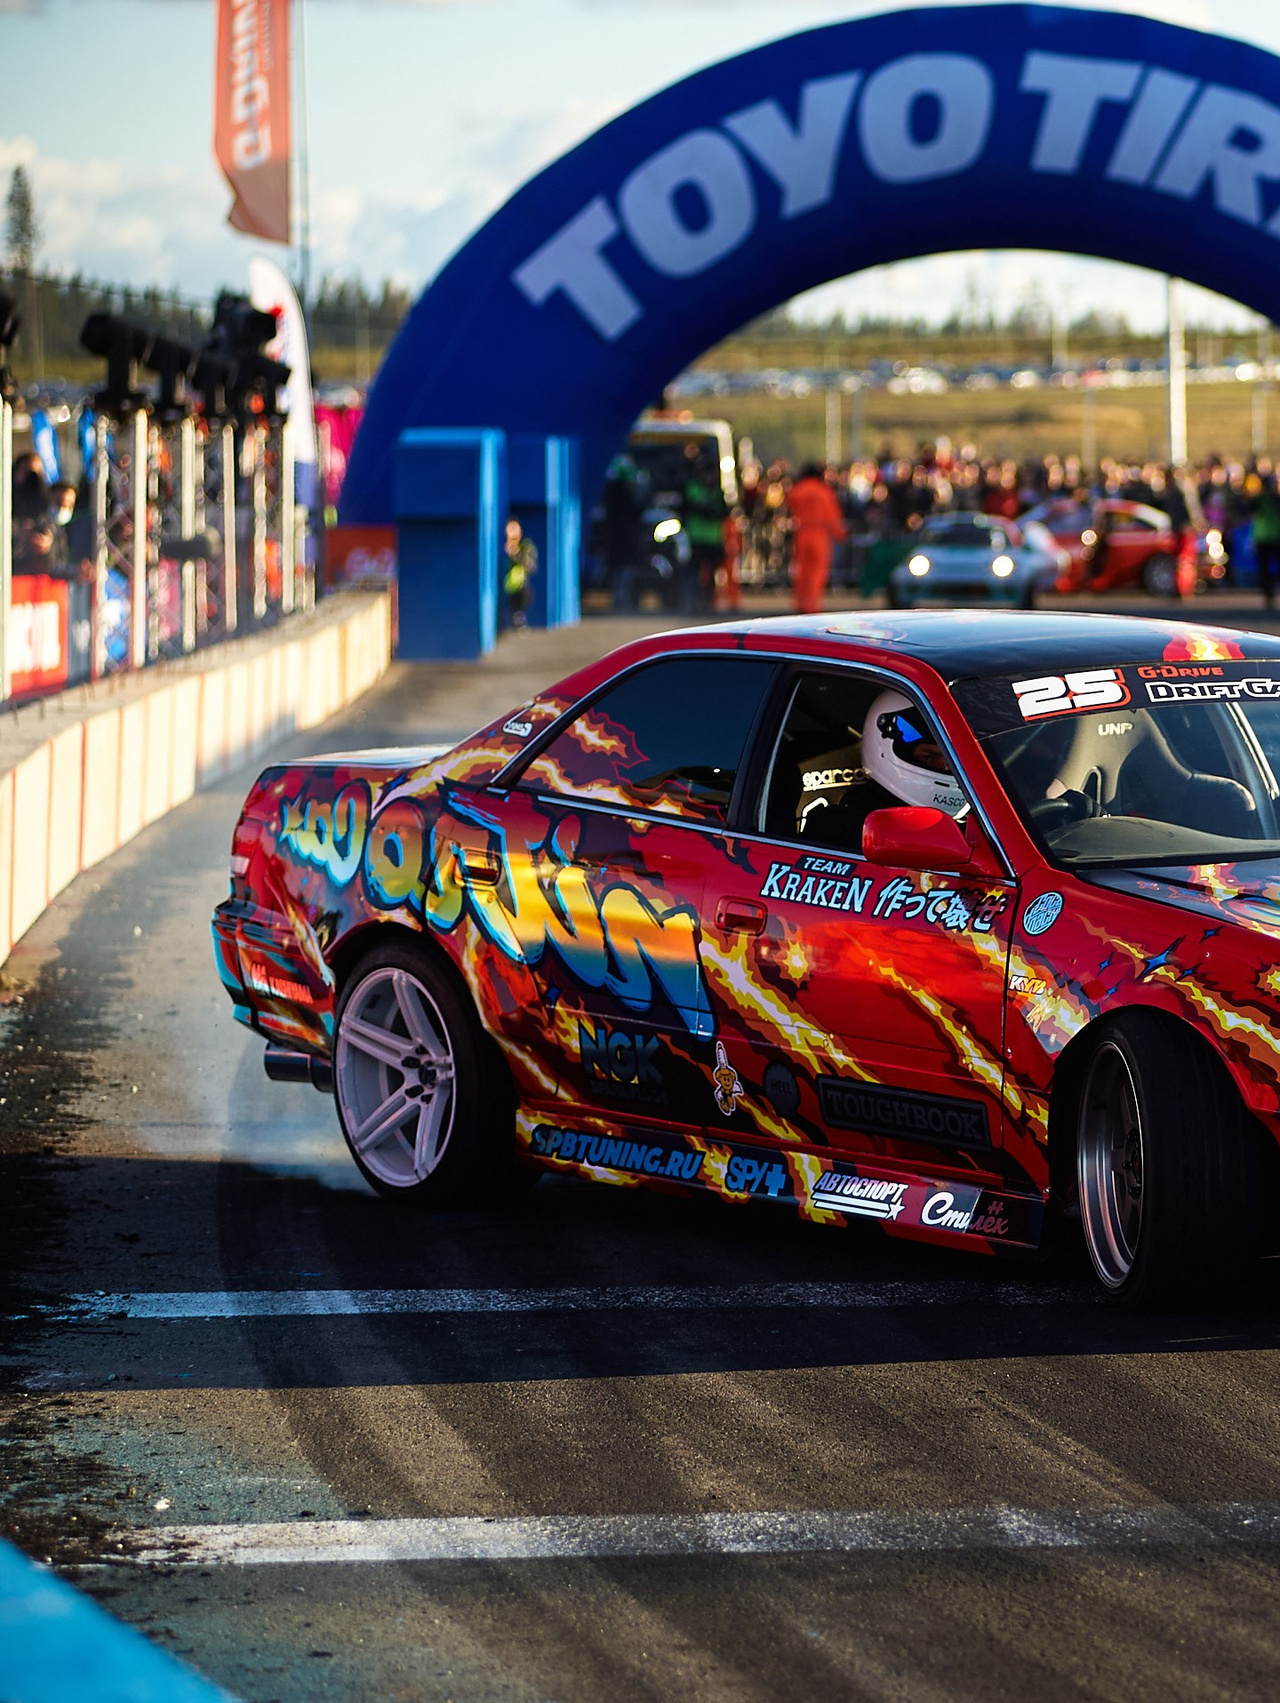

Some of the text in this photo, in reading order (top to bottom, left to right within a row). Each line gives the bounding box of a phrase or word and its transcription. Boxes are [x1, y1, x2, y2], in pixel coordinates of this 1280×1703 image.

[512, 53, 994, 342] TOYO
[1012, 669, 1128, 720] 25
[802, 768, 866, 787] sparco
[761, 863, 873, 913] KRAKEN
[804, 857, 850, 876] TEAM
[1009, 975, 1046, 995] KYB
[580, 1023, 665, 1084] NGK
[827, 1090, 982, 1140] TOUGHBOOK
[534, 1126, 704, 1179] SPBTUNING.RU
[815, 1172, 909, 1203] АВТОСПОРТ
